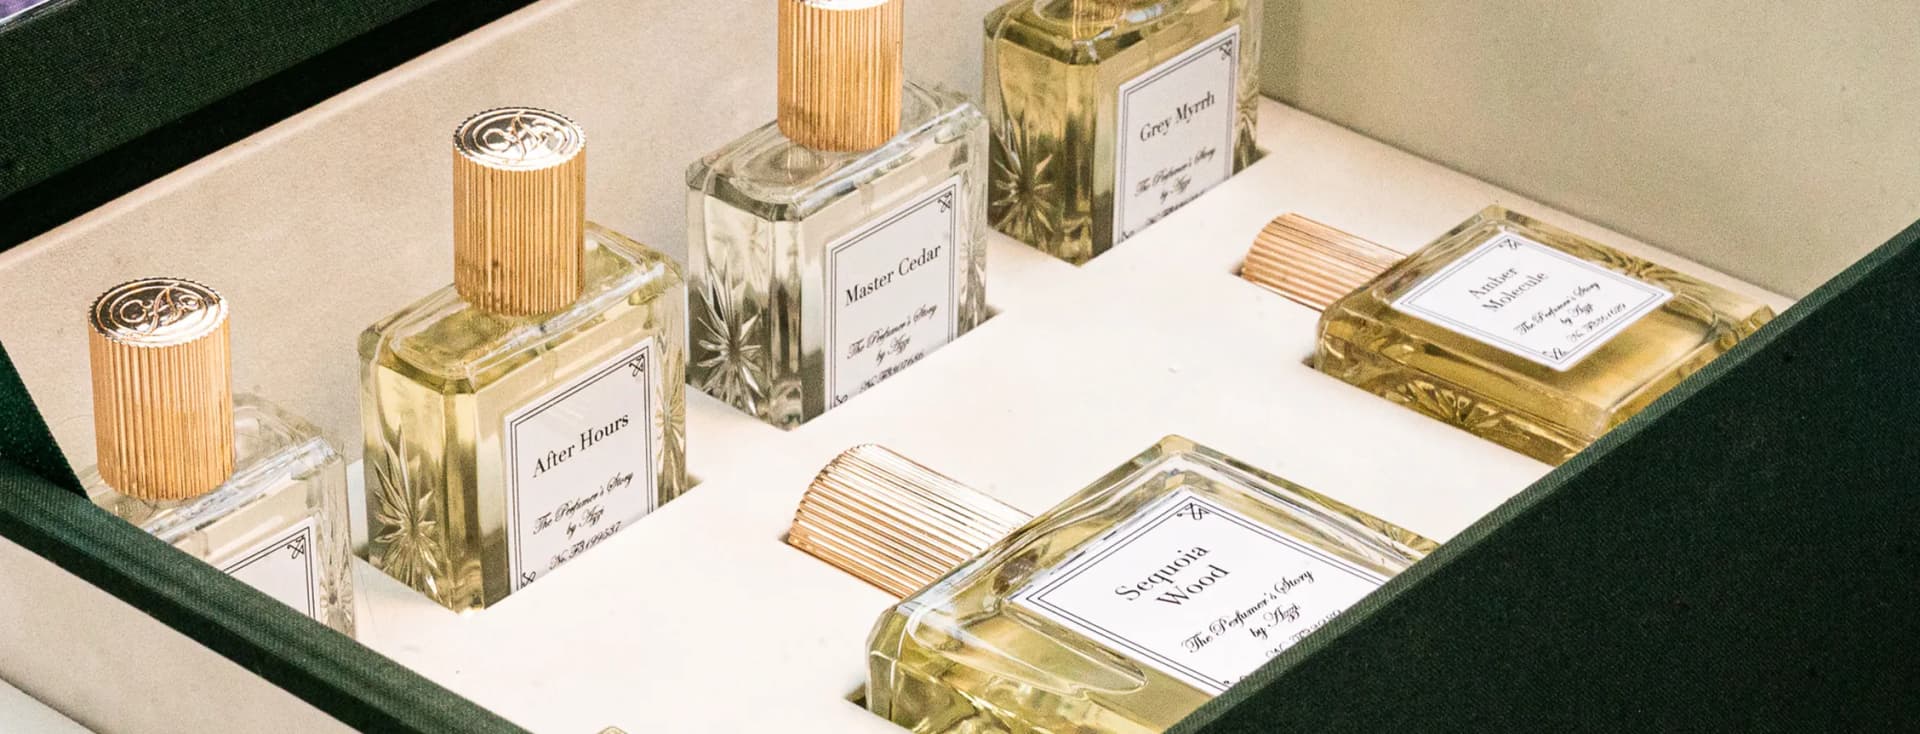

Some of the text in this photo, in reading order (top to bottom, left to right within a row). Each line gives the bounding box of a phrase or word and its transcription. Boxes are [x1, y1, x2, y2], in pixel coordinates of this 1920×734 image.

[1139, 91, 1215, 142] Grey Myrrh
[1134, 177, 1150, 197] The
[845, 245, 942, 306] Master Cedar
[1468, 267, 1518, 299] Amber
[1482, 272, 1548, 311] Molecule
[847, 304, 938, 360] The Perfumer's Story
[1513, 321, 1534, 337] The
[1574, 282, 1600, 299] Story
[1560, 317, 1573, 326] by
[875, 350, 886, 367] by
[532, 414, 630, 478] After Hours
[532, 472, 634, 535] The Perfumer's Story
[566, 523, 576, 540] by
[1114, 545, 1209, 601] Sequoia
[1156, 564, 1230, 607] Wood
[1180, 632, 1214, 655] The
[1209, 590, 1278, 638] Perfumer's
[1274, 569, 1314, 595] Story
[1249, 626, 1268, 640] by
